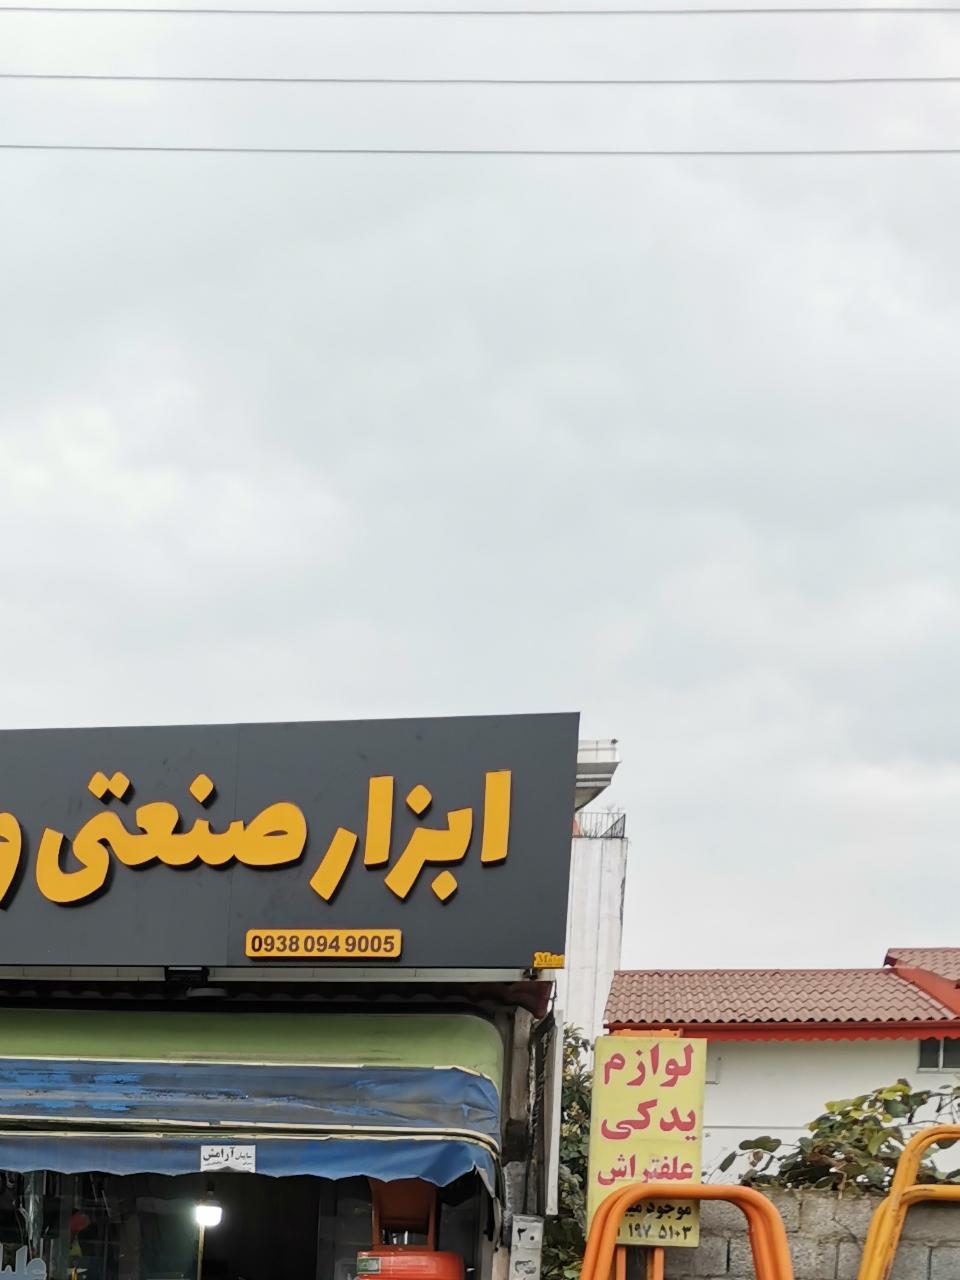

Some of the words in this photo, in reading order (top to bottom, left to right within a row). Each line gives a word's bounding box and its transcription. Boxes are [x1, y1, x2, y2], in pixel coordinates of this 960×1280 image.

[35, 771, 307, 903] صنعتی
[310, 769, 512, 901] ابزار
[603, 1043, 695, 1088] لوازم
[600, 1099, 698, 1141] یدکی
[646, 1202, 692, 1220] موجود
